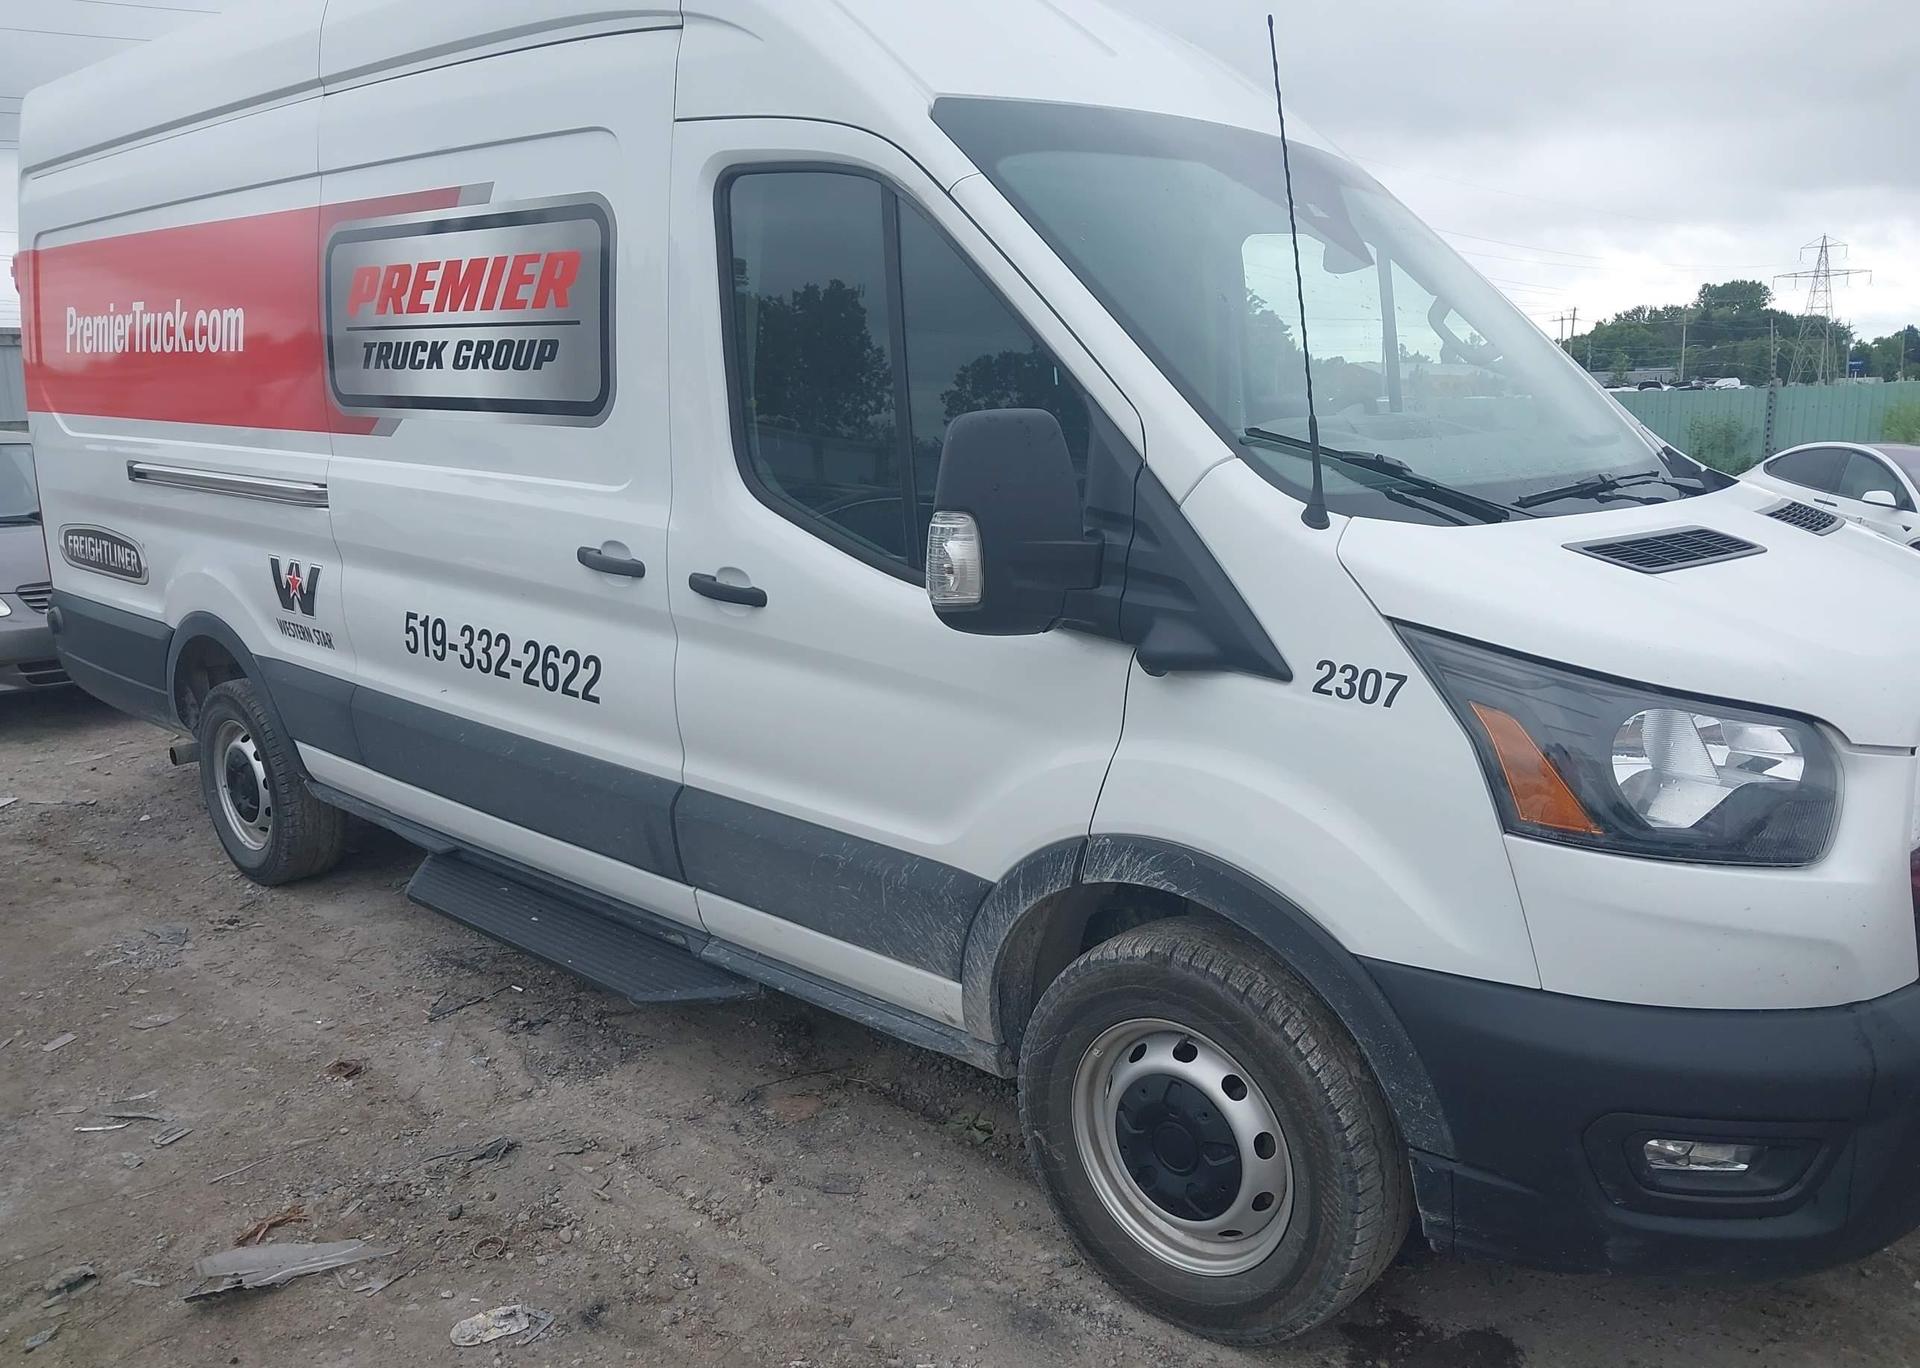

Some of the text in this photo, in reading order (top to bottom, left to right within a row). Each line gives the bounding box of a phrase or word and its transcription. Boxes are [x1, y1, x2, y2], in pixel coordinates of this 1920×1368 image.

[347, 250, 582, 318] PREMIER
[65, 298, 245, 353] PremierTruck.com
[362, 338, 560, 371] TRUCK GROUP
[67, 534, 140, 573] FREIGHTLINER
[275, 617, 336, 650] WESTERN STAR
[404, 610, 602, 704] 519-332-2622
[1311, 659, 1408, 708] 2307
